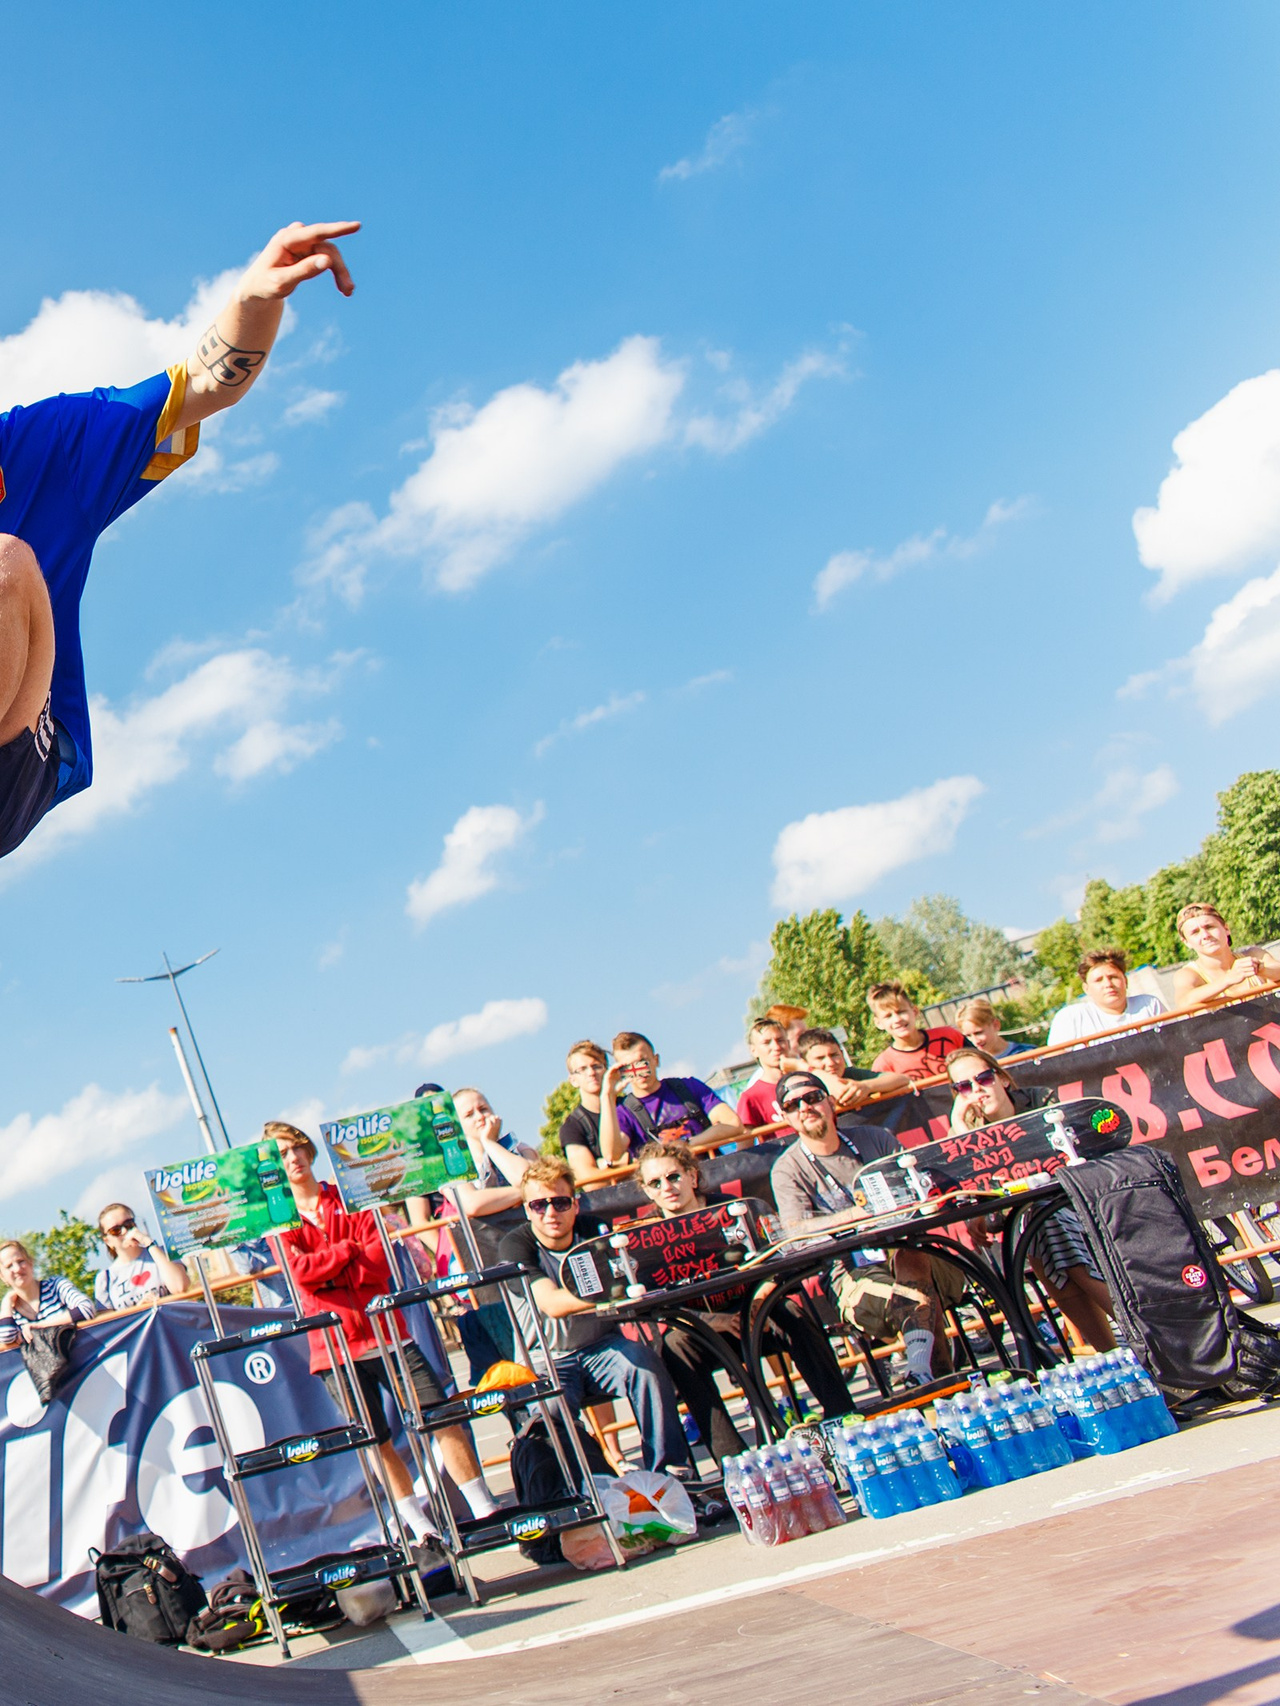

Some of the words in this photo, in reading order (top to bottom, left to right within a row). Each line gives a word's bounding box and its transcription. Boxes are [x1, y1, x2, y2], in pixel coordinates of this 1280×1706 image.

[939, 1122, 1027, 1163] SKATE
[971, 1147, 1016, 1172] AND
[616, 1206, 734, 1252] DESTROYE
[663, 1242, 696, 1263] AND
